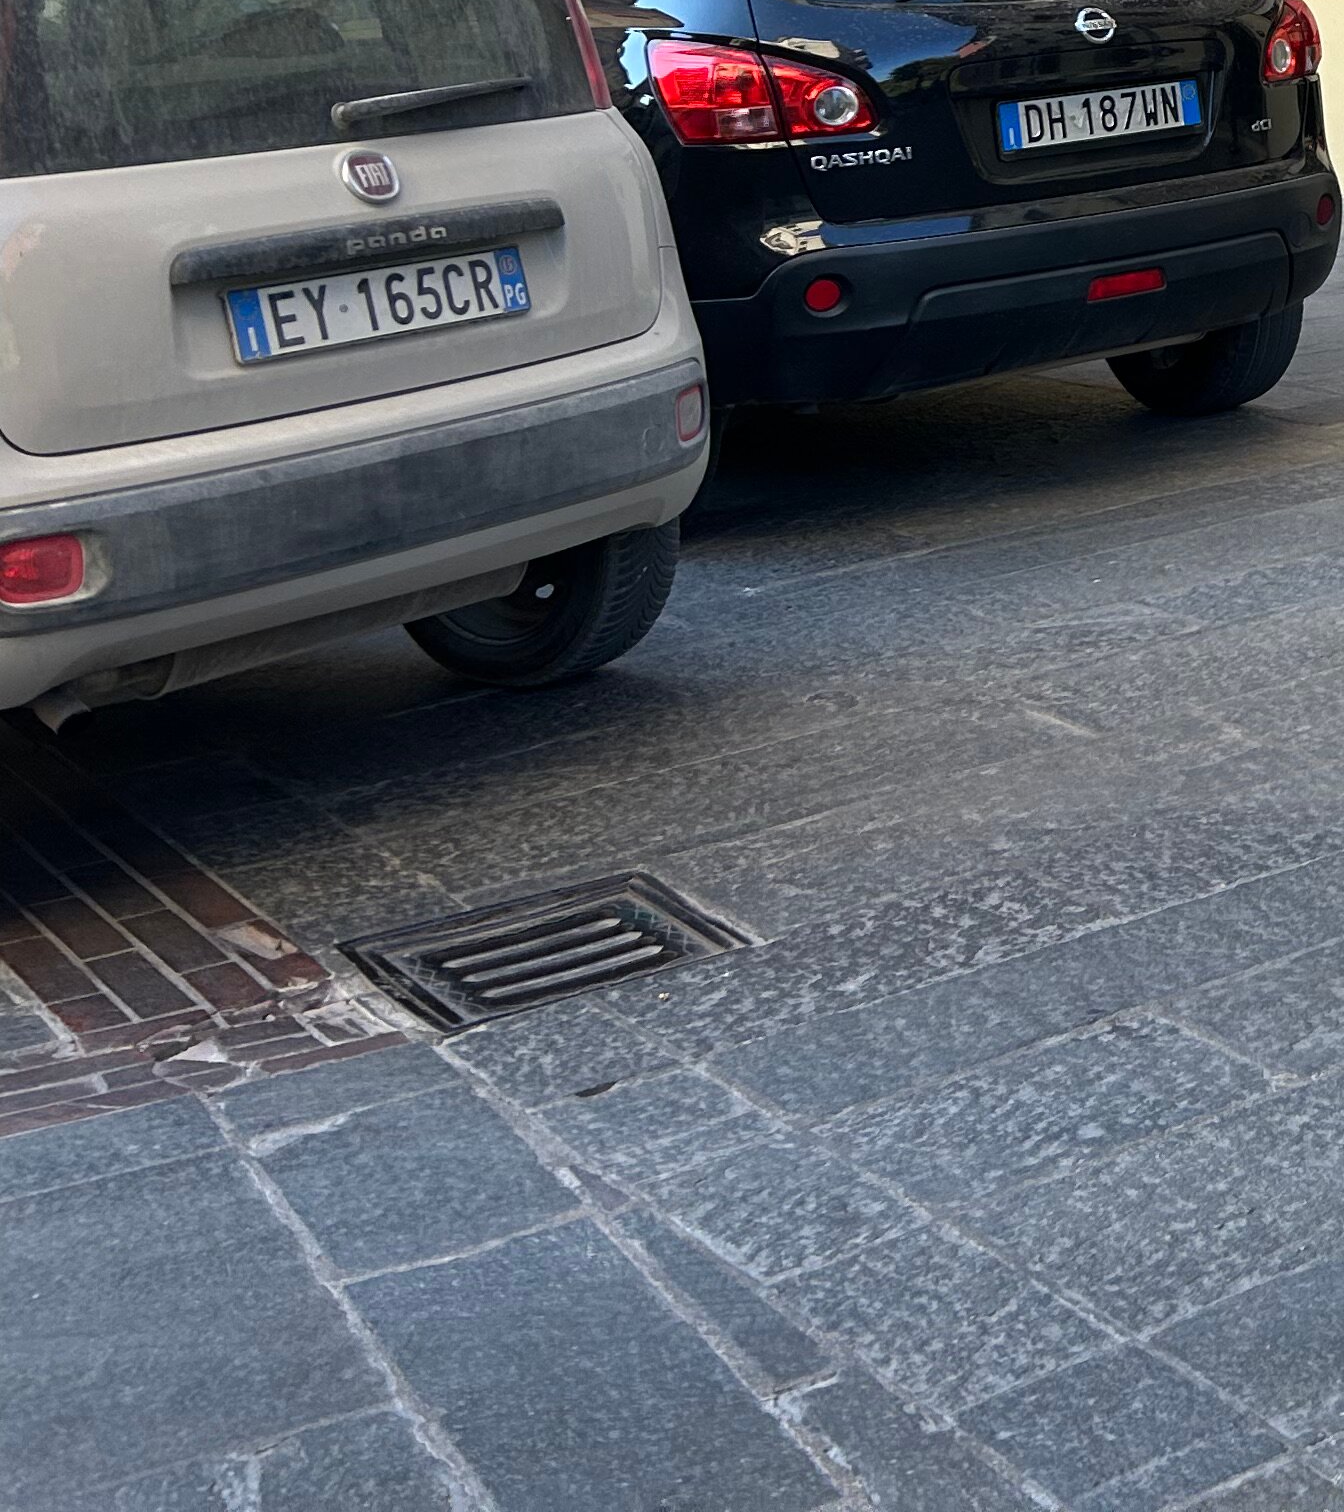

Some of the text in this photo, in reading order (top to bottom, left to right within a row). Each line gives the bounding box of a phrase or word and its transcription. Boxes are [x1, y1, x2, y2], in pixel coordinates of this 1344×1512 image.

[1024, 84, 1181, 144] DH 187WN
[810, 146, 913, 172] QASHQAI
[354, 162, 391, 188] FIAT
[346, 225, 448, 256] panda
[268, 258, 500, 349] EY 165CR
[504, 282, 527, 307] PG
